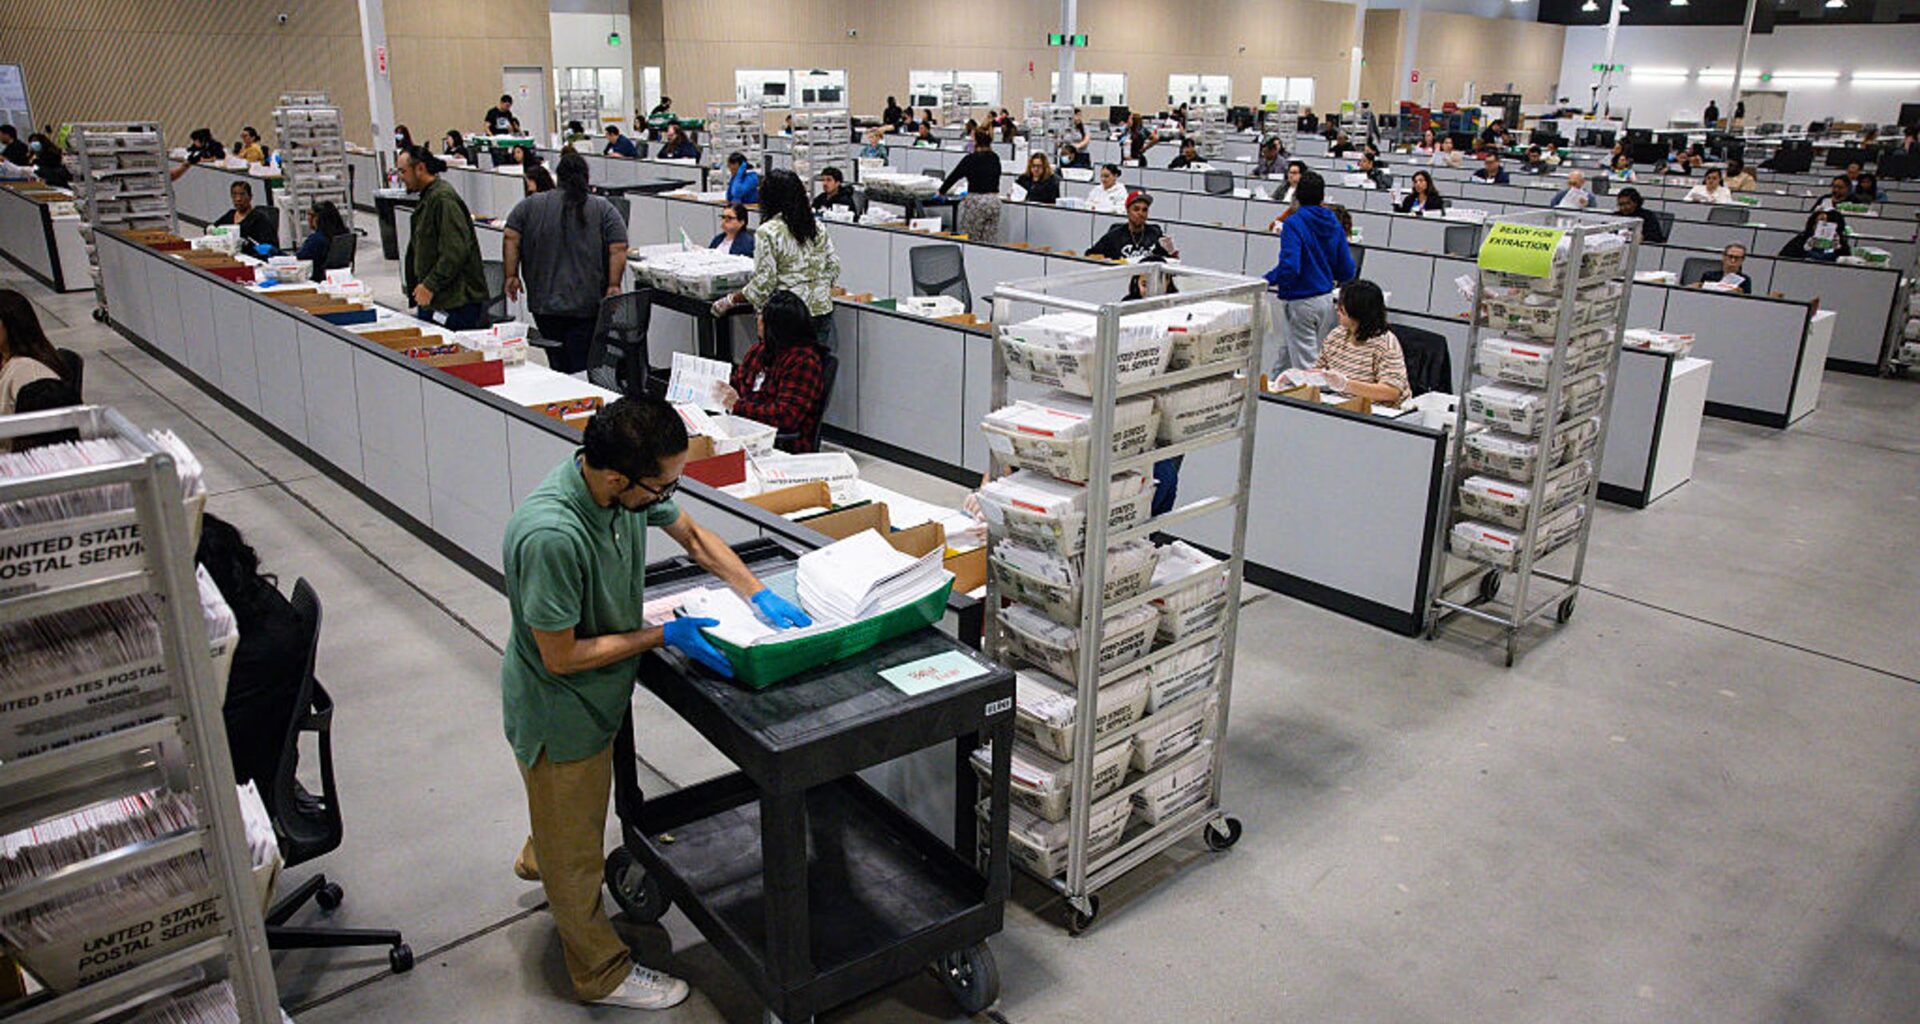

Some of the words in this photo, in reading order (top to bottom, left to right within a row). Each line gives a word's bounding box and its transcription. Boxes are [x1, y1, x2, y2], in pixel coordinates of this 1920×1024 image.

[1489, 237, 1552, 251] EXTRACTION
[1499, 226, 1532, 235] READY
[1132, 357, 1160, 370] SERVICE
[79, 524, 141, 549] STATE
[0, 556, 73, 580] OSTAL
[79, 541, 145, 566] SERVI
[0, 696, 39, 713] ITED
[44, 678, 104, 702] STATES
[107, 664, 166, 689] POSTAL
[84, 921, 154, 952] UNITED
[160, 895, 221, 927] STATE
[79, 937, 153, 971] POSTAL
[161, 911, 225, 941] SERVI
